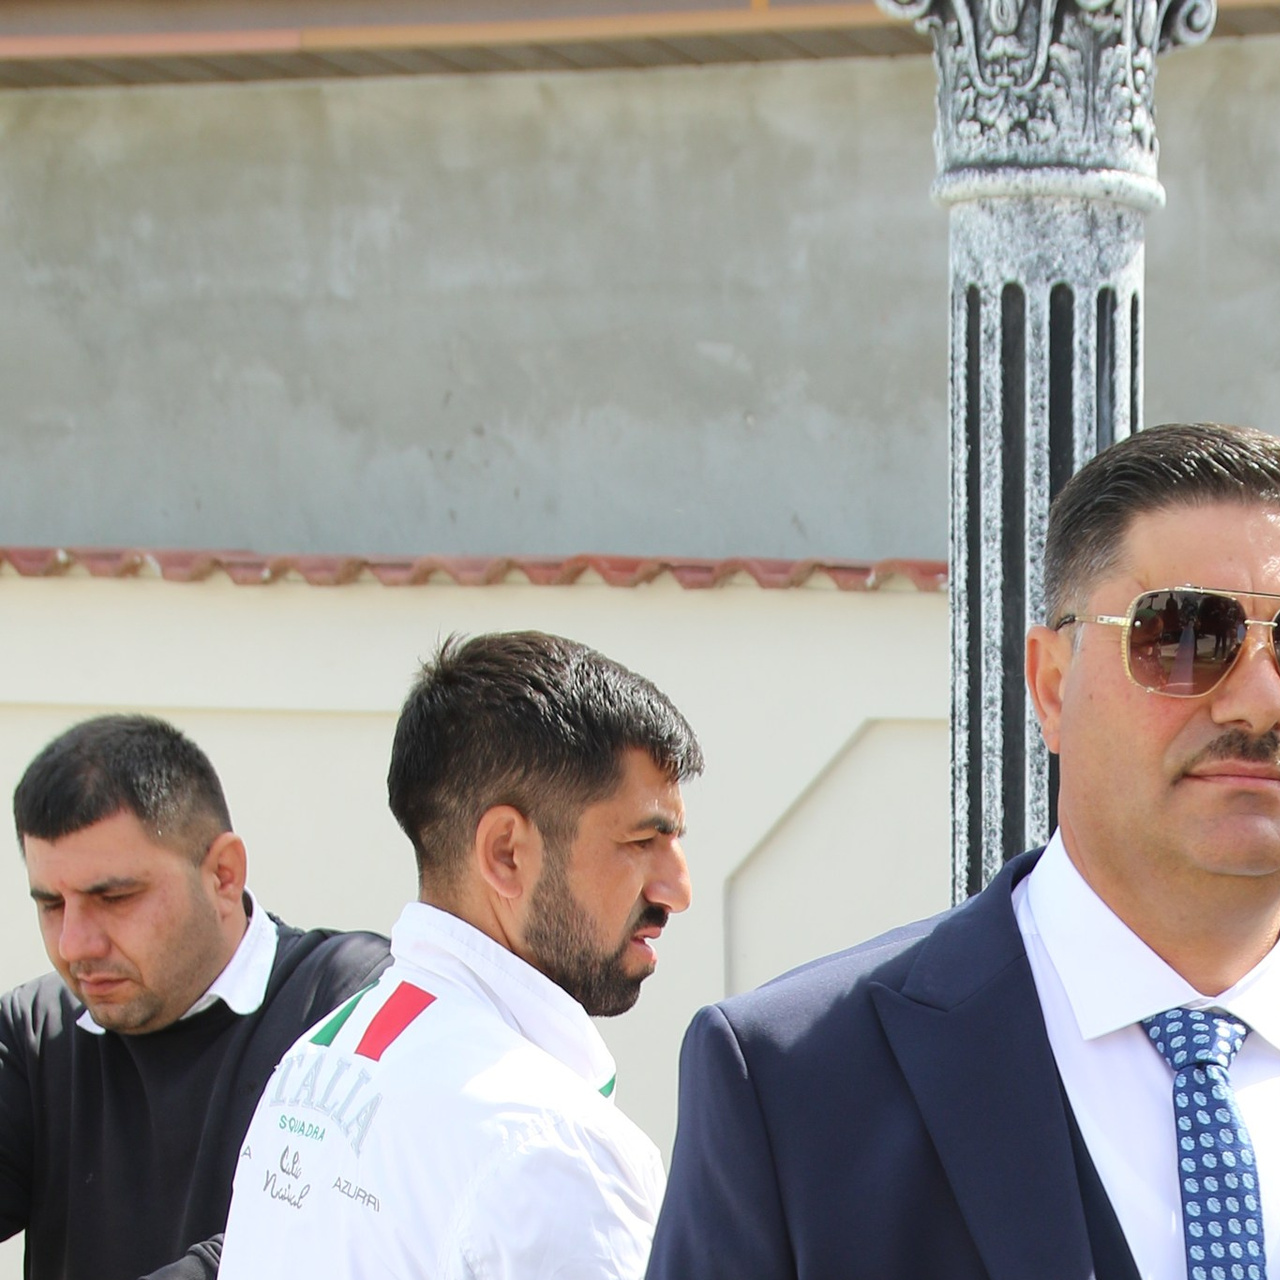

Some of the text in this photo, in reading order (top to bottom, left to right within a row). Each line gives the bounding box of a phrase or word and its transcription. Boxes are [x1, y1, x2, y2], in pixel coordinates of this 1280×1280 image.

[269, 1053, 383, 1158] TALIA
[279, 1114, 326, 1142] SQUADRA
[332, 1177, 380, 1212] AZURRI
